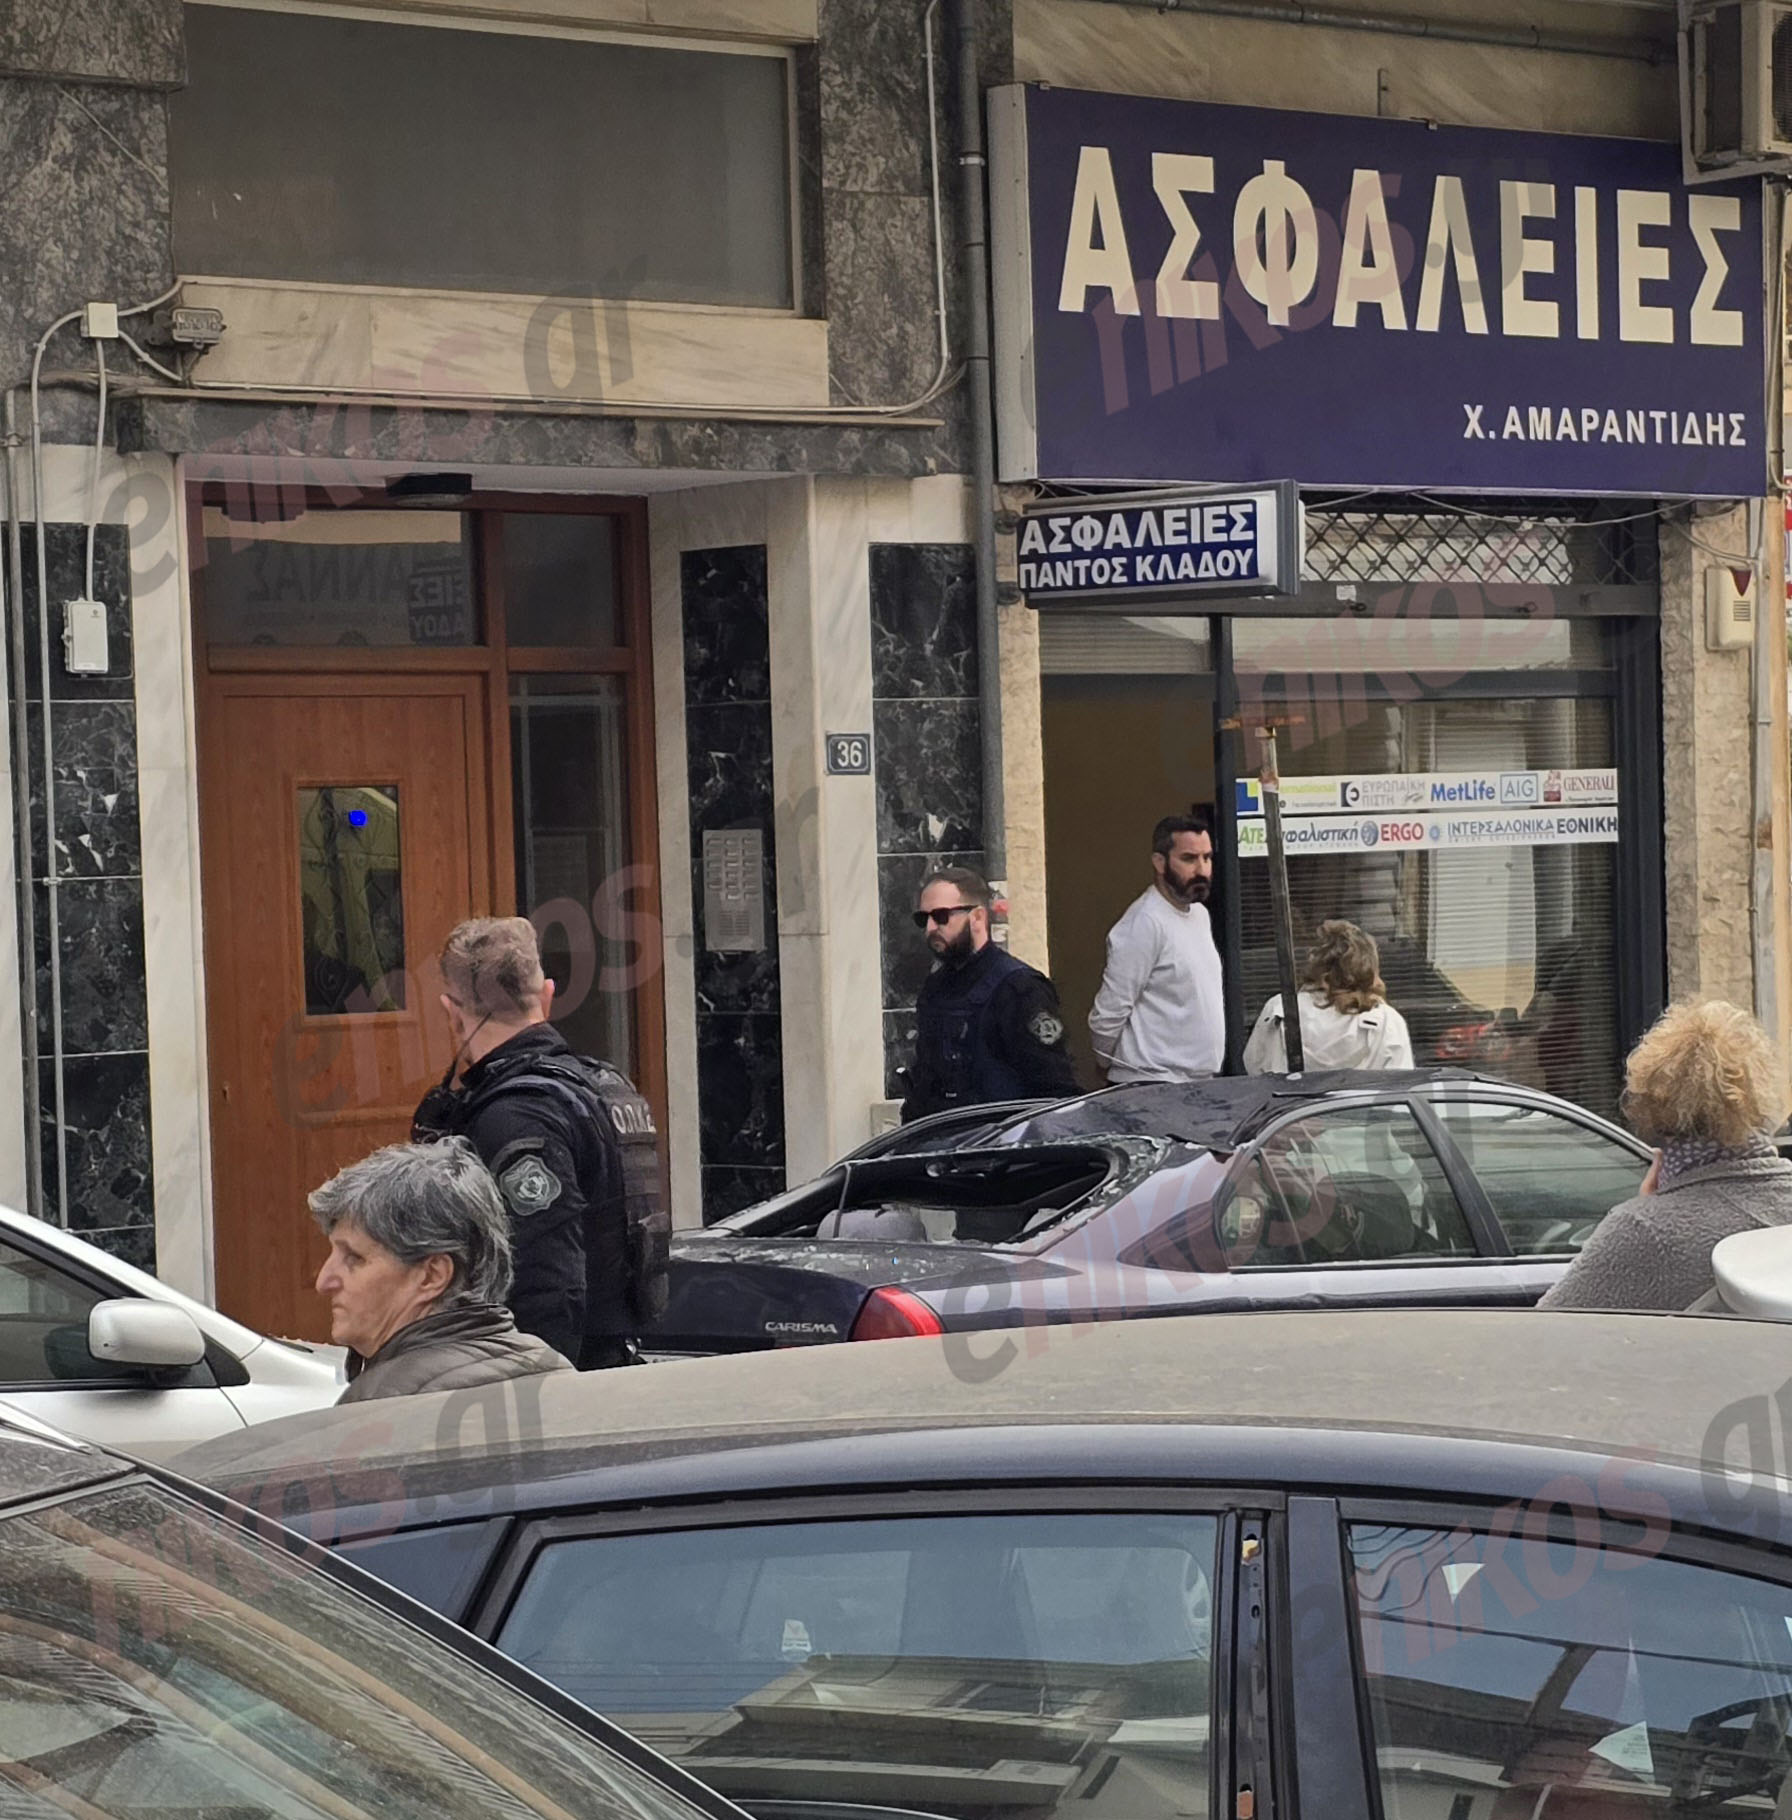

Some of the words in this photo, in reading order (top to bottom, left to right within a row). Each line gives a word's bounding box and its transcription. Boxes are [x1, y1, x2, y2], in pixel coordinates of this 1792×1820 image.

[1058, 146, 1744, 347] ΑΣΦΑΛΕΙΕΣ
[1019, 504, 1255, 556] ΑΣΦΑΛΕΙΕΣ
[1019, 557, 1128, 589] ΠΑΝΤΟΣ
[1135, 549, 1254, 582] ΚΛΑΔΟΥ
[837, 741, 863, 767] 36
[1431, 779, 1496, 802] MetLife
[1504, 779, 1534, 798] AIG
[1563, 775, 1615, 791] GENERALI
[1381, 823, 1425, 841] ERGO
[765, 1321, 838, 1334] CARISMA
